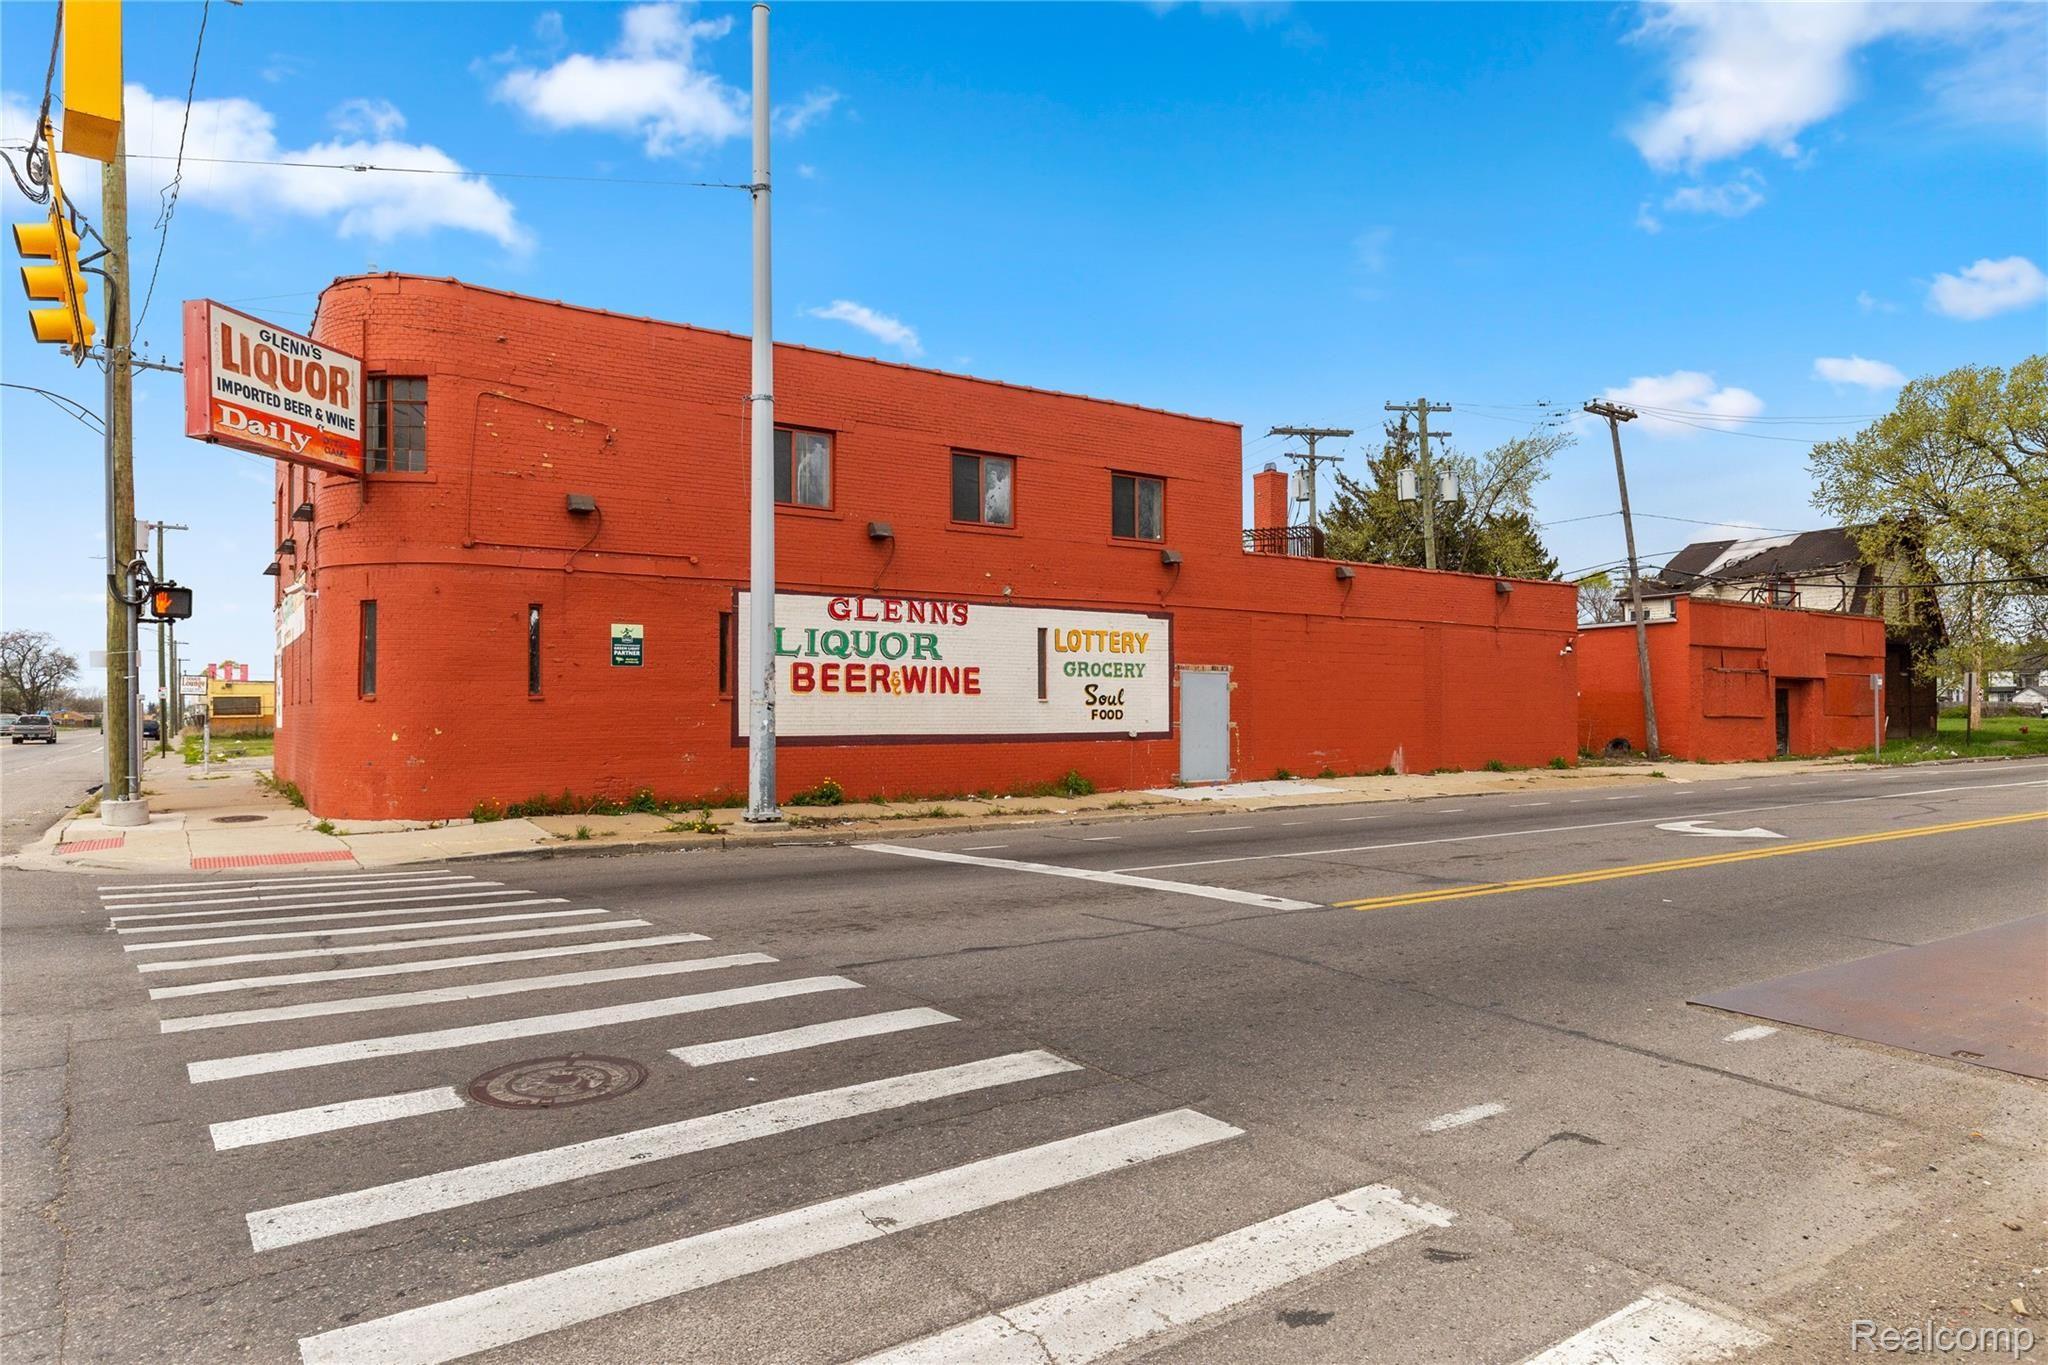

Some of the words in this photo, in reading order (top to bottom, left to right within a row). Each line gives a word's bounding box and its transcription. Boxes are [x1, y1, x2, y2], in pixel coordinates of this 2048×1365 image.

[260, 329, 323, 360] GLENN'S
[221, 322, 350, 409] LIQUOR
[217, 377, 281, 408] IMPORTED
[284, 397, 313, 418] BEER
[315, 408, 325, 422] &
[325, 410, 356, 431] WINE
[217, 403, 312, 453] Daily
[774, 627, 943, 660] LIQUOR
[1054, 628, 1149, 654] LOTTERY
[1063, 661, 1146, 678] GROCERY
[1084, 683, 1125, 706] Soul
[1091, 709, 1124, 720] FOOD
